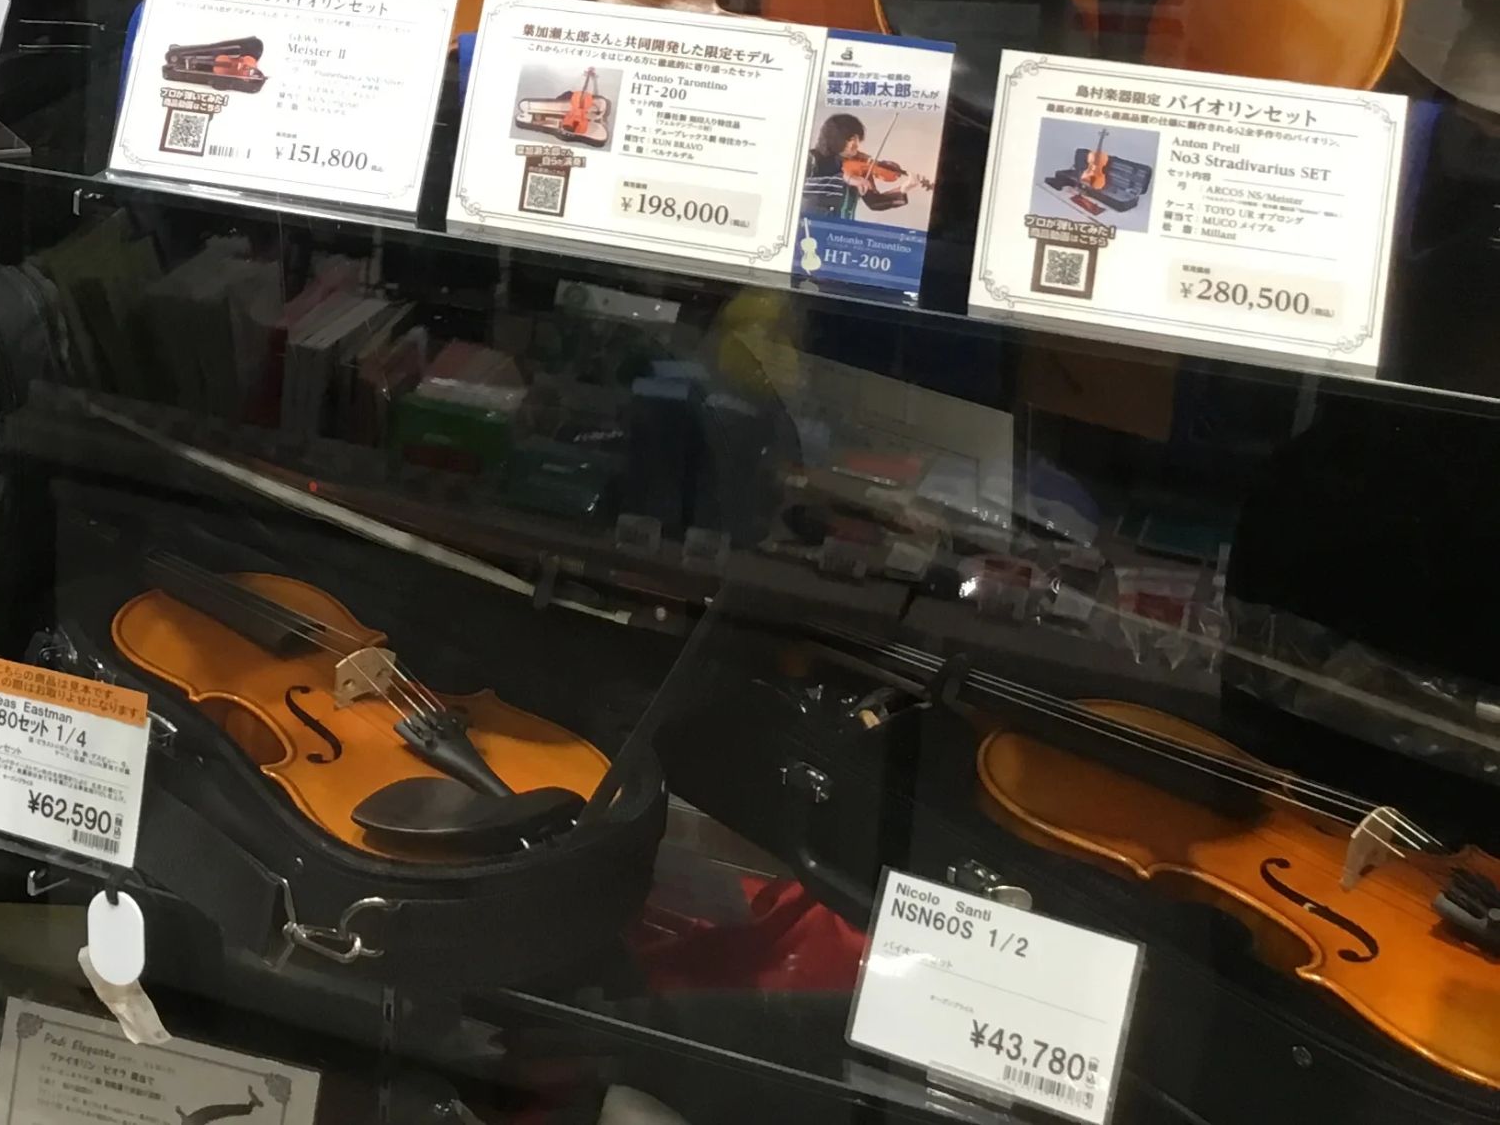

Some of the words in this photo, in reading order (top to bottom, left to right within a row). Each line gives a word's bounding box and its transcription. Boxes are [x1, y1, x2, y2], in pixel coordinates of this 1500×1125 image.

[287, 42, 332, 58] Meister
[522, 23, 775, 65] 葉加瀬太郎さんと共同開発した限定モデル
[631, 84, 687, 101] HT-200
[633, 71, 674, 85] Antonio
[678, 76, 728, 91] Tarontino
[1075, 84, 1162, 108] 島村楽器限定
[1166, 93, 1318, 127] バイオリンセット
[275, 142, 368, 172] ¥151,800
[1171, 136, 1208, 150] Anton
[1211, 140, 1241, 154] Prell
[1170, 149, 1201, 166] No3
[1204, 153, 1296, 177] Stradivarius
[1300, 166, 1332, 182] SET
[1206, 185, 1245, 198] ARCOS
[621, 193, 729, 226] ¥198,000
[1204, 204, 1236, 217] TOYO
[1201, 227, 1238, 241] Millant
[1202, 216, 1238, 230] MUCO
[826, 232, 863, 246] Antonio
[866, 237, 912, 253] Tarontino
[823, 247, 891, 272] HT-200
[1180, 277, 1310, 315] ¥280,500
[23, 701, 73, 725] Eastman
[56, 724, 88, 748] 1/4
[27, 788, 112, 835] ¥62,590
[895, 881, 941, 907] Nicolo
[954, 900, 992, 922] Santi
[890, 897, 974, 940] NSN60S
[988, 928, 1030, 958] 1/2
[969, 1019, 1087, 1082] ¥43,780
